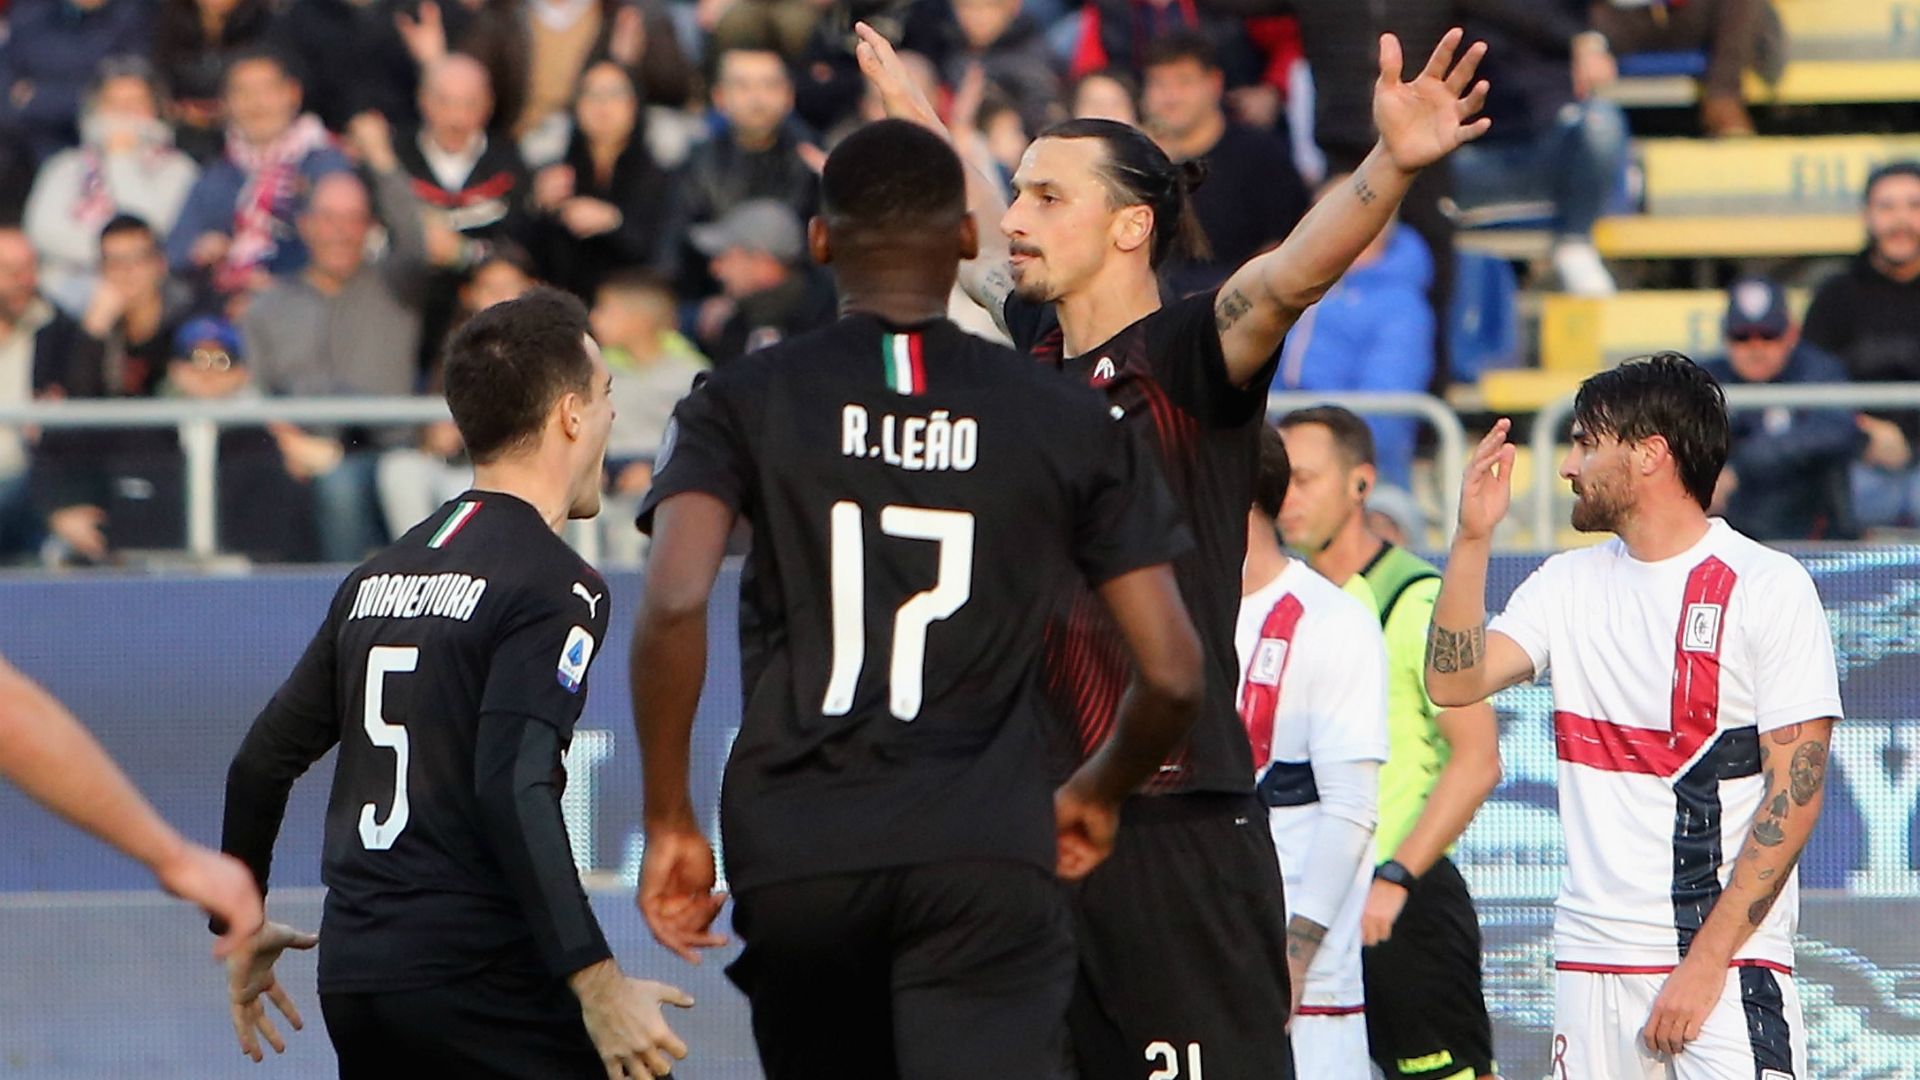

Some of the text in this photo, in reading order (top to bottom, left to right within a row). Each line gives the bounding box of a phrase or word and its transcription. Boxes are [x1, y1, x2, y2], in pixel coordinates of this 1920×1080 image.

[842, 404, 978, 471] R.LEÃO
[822, 500, 975, 722] 17
[358, 645, 419, 850] 5
[1145, 1041, 1203, 1080] 21
